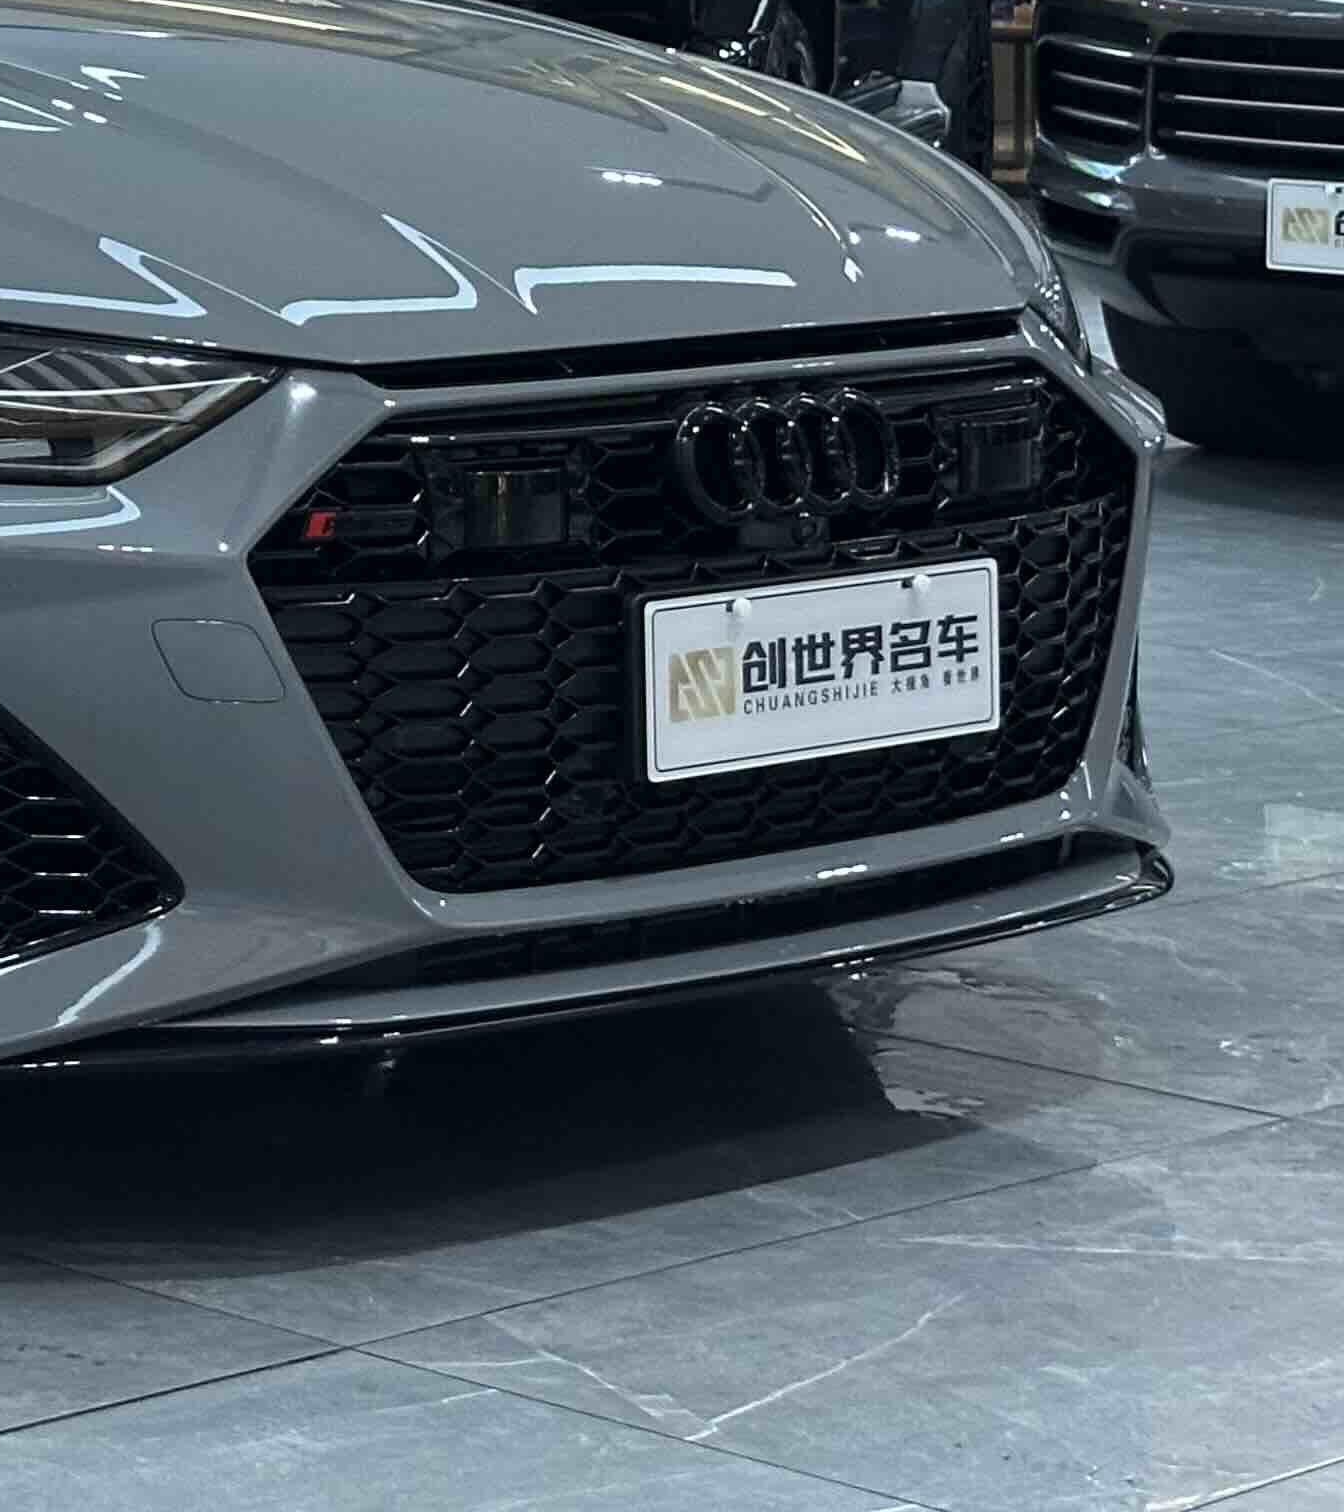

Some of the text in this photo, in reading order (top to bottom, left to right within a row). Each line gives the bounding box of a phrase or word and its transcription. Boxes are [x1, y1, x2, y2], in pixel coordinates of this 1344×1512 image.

[740, 614, 980, 694] 创世界名车
[743, 680, 879, 715] CHUANGSHIJIE
